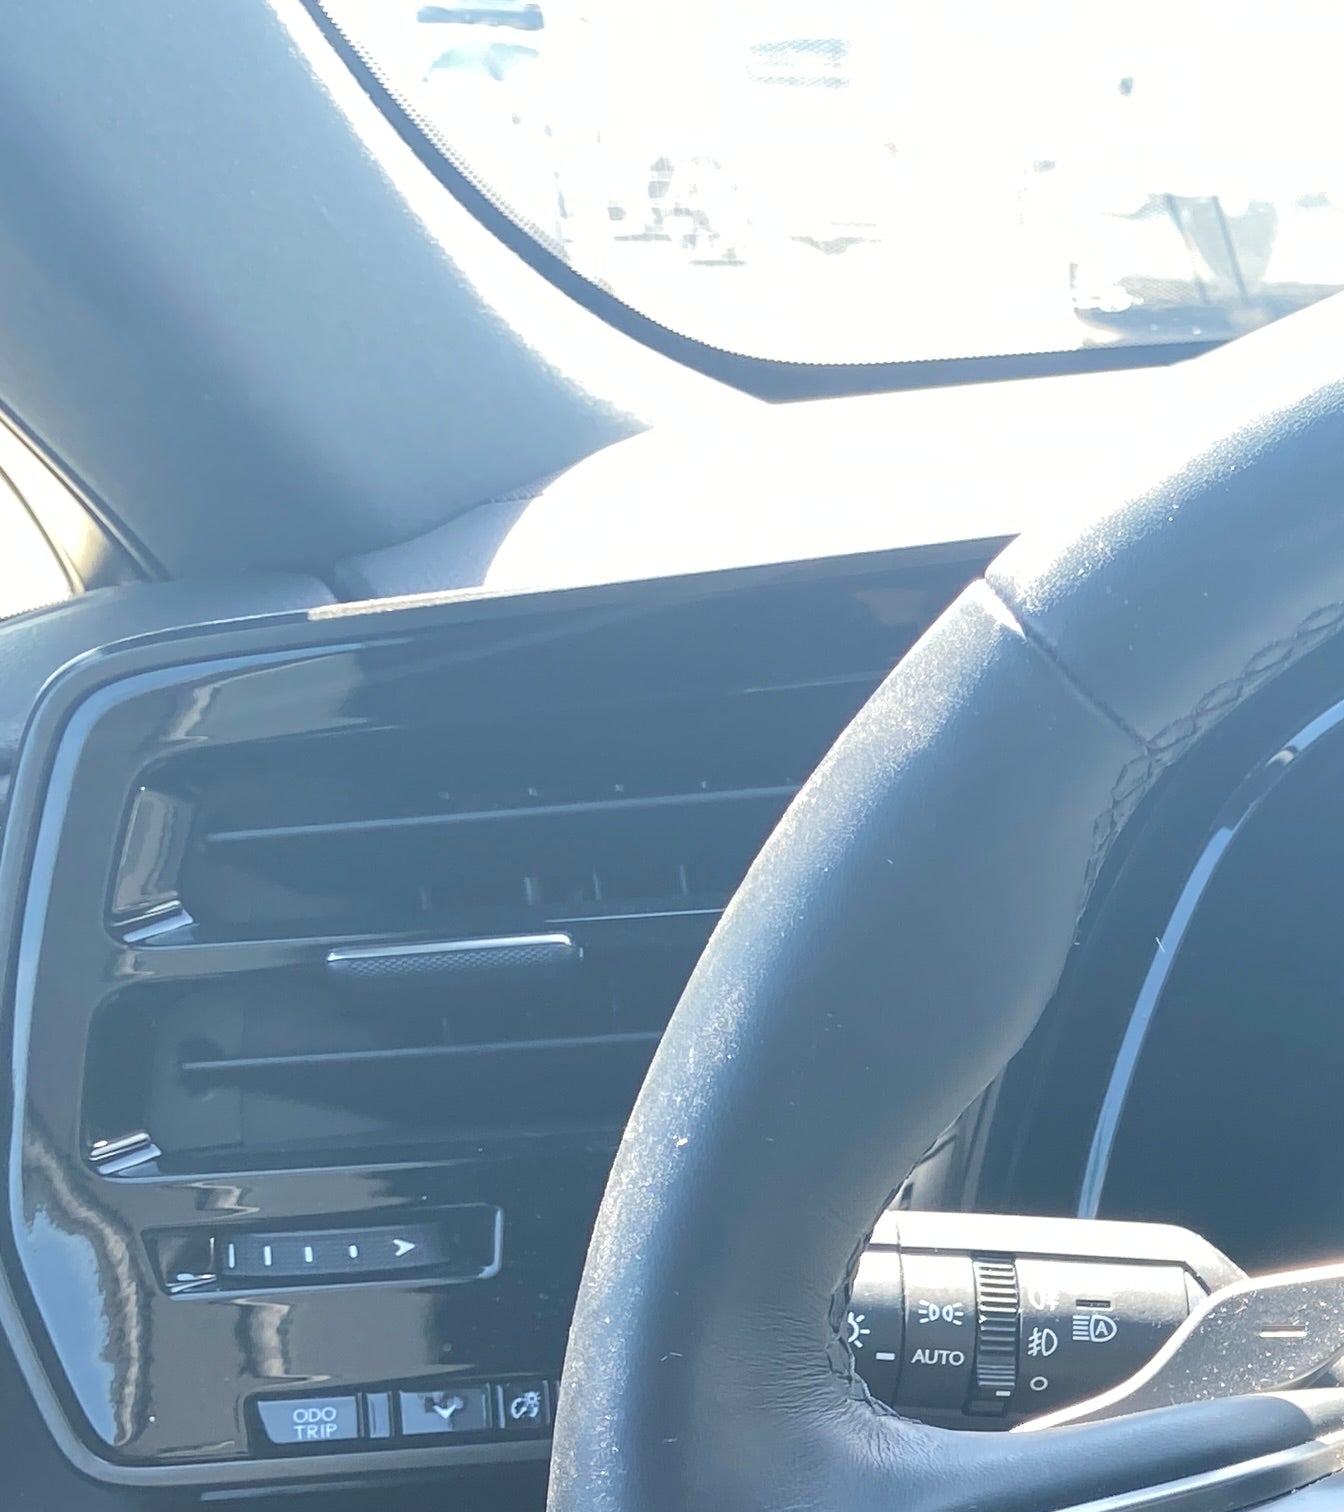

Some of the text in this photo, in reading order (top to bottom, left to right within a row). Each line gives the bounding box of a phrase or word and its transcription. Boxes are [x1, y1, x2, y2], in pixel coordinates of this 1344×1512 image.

[911, 1348, 965, 1366] AUTO
[293, 1406, 337, 1424] ODO
[293, 1423, 338, 1440] TRIP
